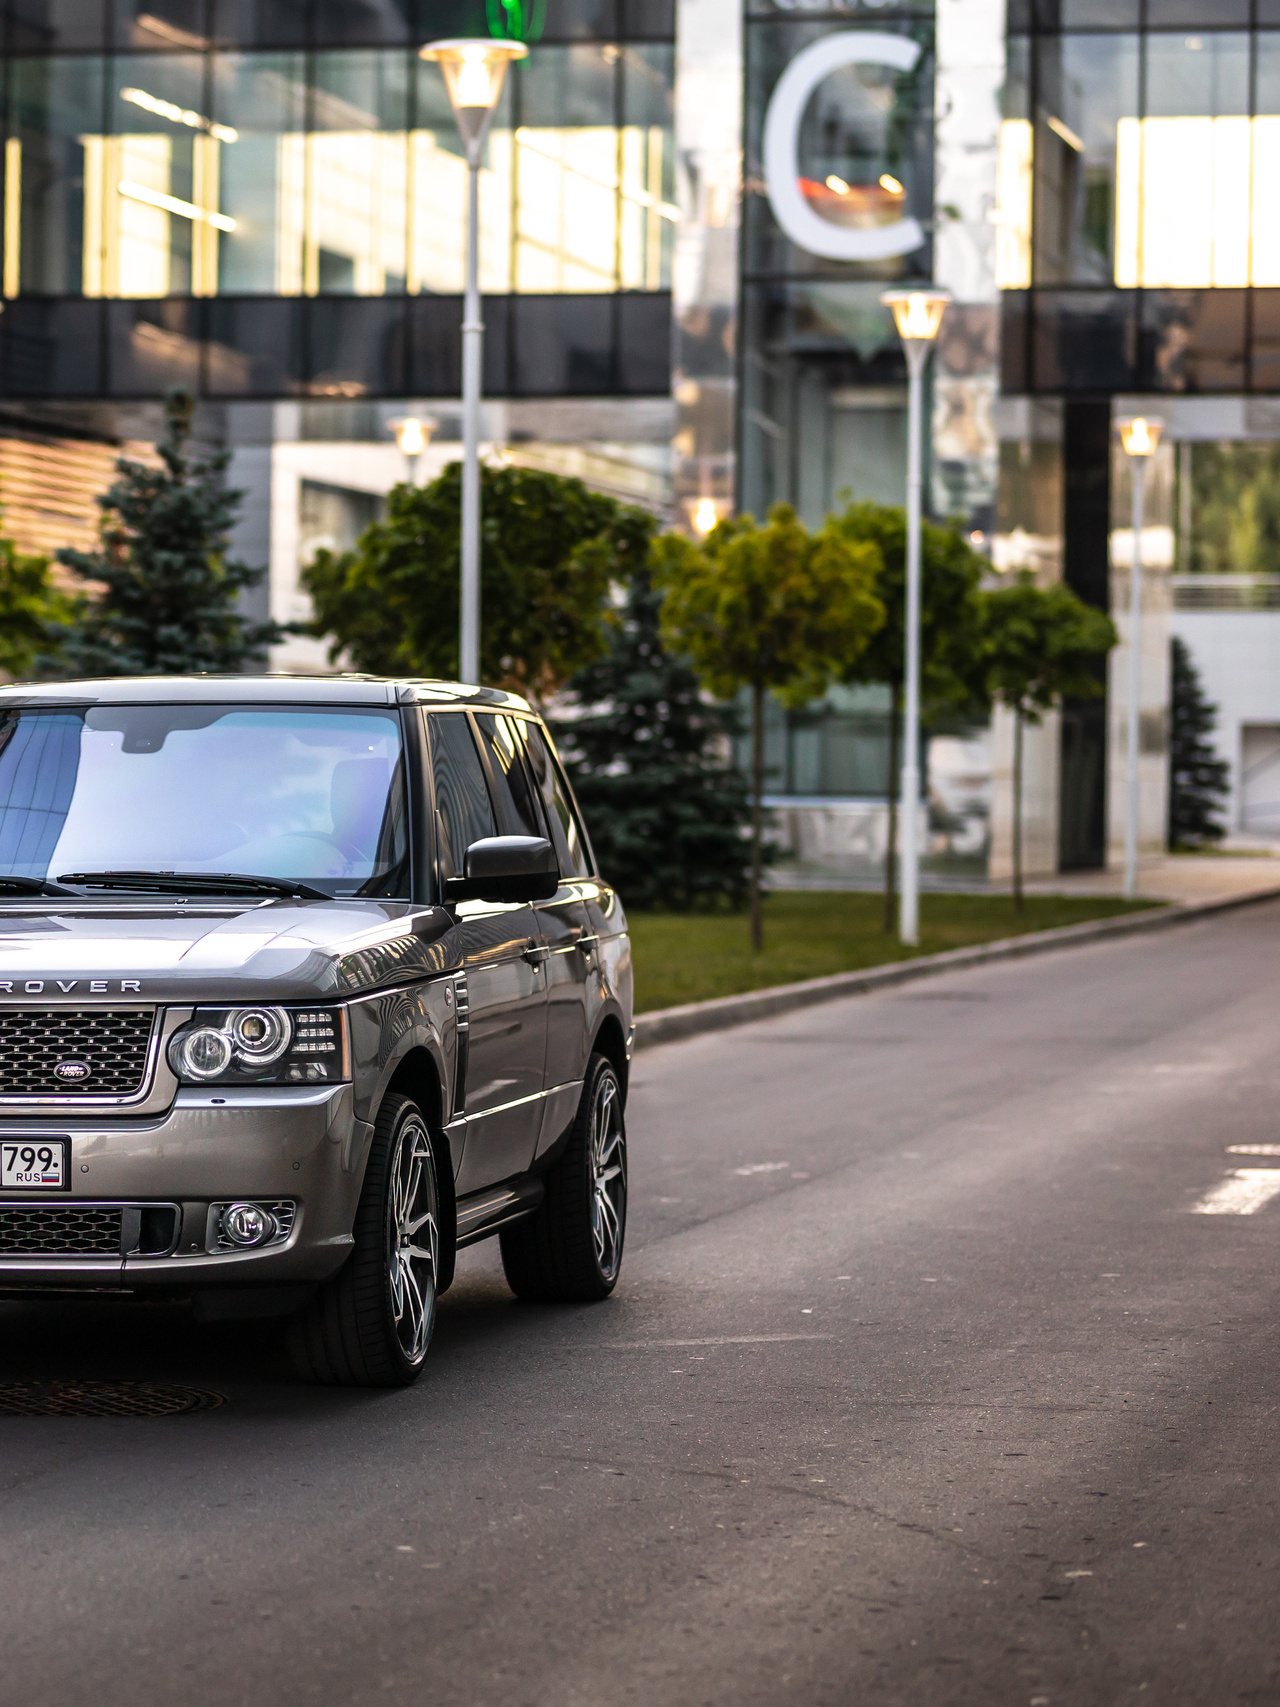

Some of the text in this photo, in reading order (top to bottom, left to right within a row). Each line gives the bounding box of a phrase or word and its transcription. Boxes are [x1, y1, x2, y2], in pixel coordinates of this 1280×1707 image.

[763, 30, 925, 261] C
[3, 1146, 53, 1172] 799
[16, 1172, 41, 1182] RUS
